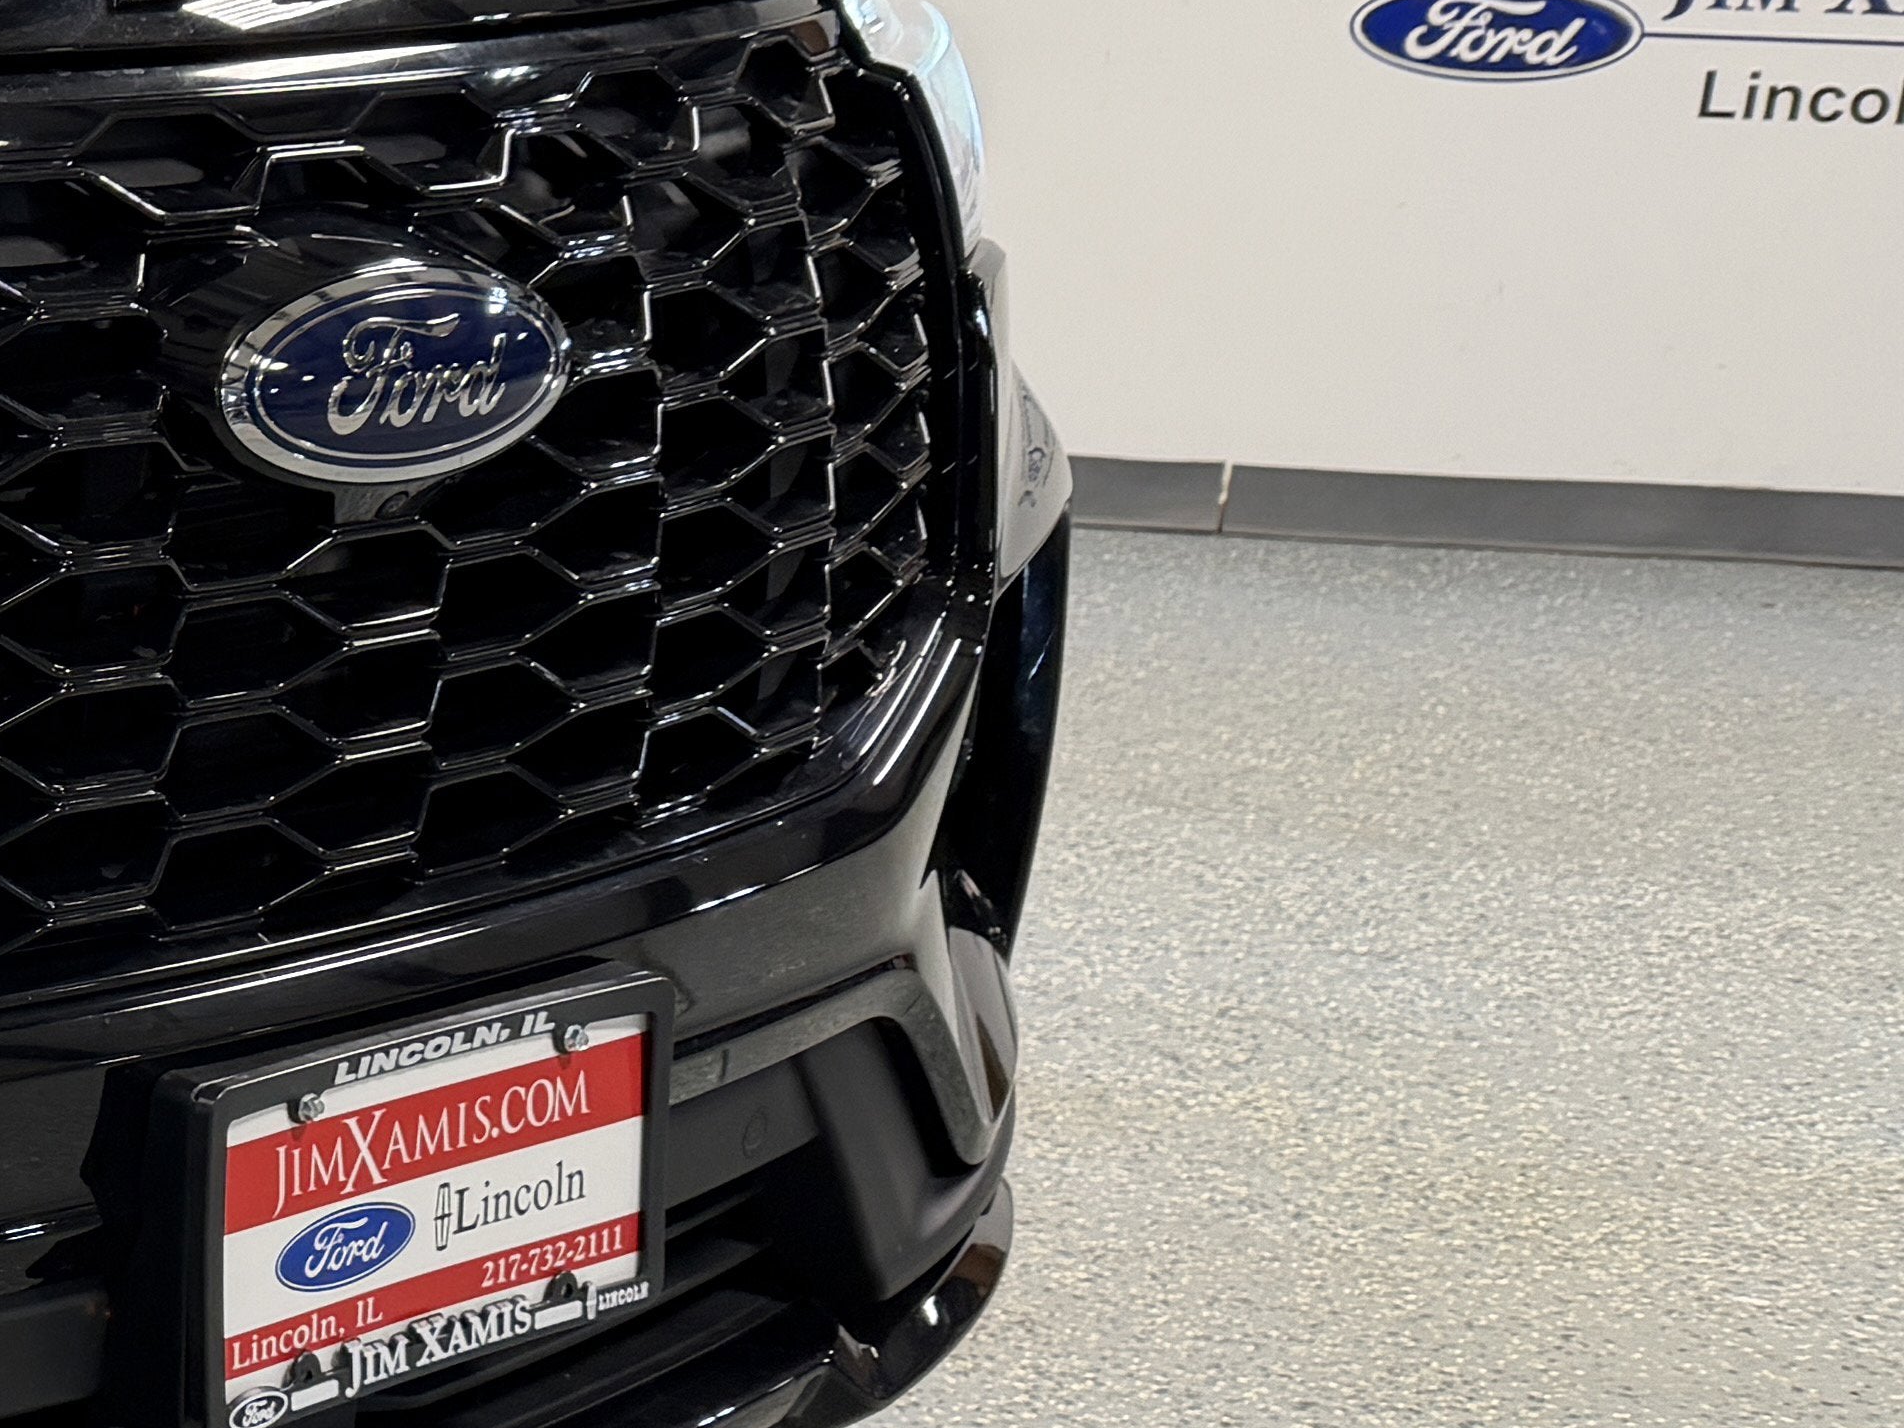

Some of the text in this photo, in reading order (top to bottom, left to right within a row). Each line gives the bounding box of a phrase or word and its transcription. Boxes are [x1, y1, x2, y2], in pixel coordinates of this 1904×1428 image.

[327, 312, 507, 436] Ford
[334, 1012, 555, 1085] LINCOLN, IL
[273, 1070, 591, 1219] JIMXAMIS.COM
[453, 1160, 586, 1235] Lincoln
[304, 1217, 386, 1279] Ford
[481, 1225, 623, 1288] 217-732-2111
[598, 1281, 649, 1310] LINCOLN
[232, 1299, 383, 1371] Lincoln, IL
[345, 1299, 534, 1398] JIM XAMIS
[242, 1400, 276, 1427] Ford
